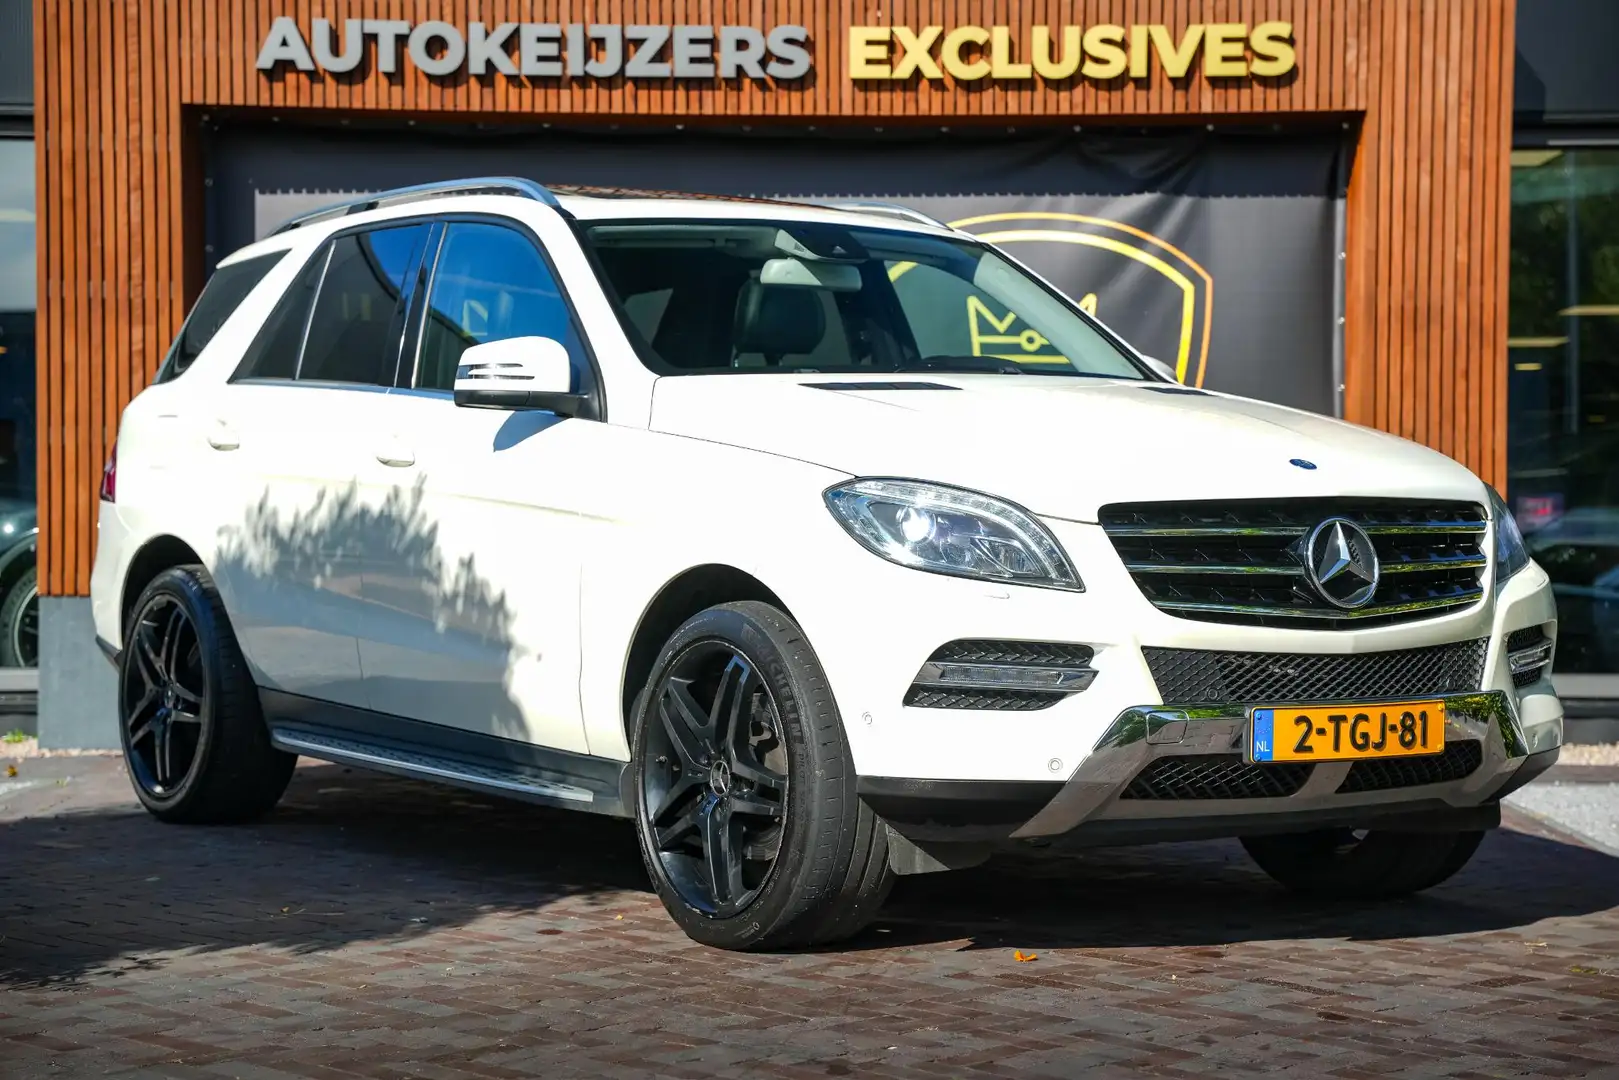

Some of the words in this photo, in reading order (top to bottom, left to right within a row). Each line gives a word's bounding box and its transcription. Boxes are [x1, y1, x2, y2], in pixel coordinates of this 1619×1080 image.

[255, 17, 812, 79] AUTOKEIJZERS
[849, 22, 1296, 80] EXCLUSIVES
[1255, 740, 1270, 752] NL
[1293, 711, 1428, 753] 2-TGJ-81
